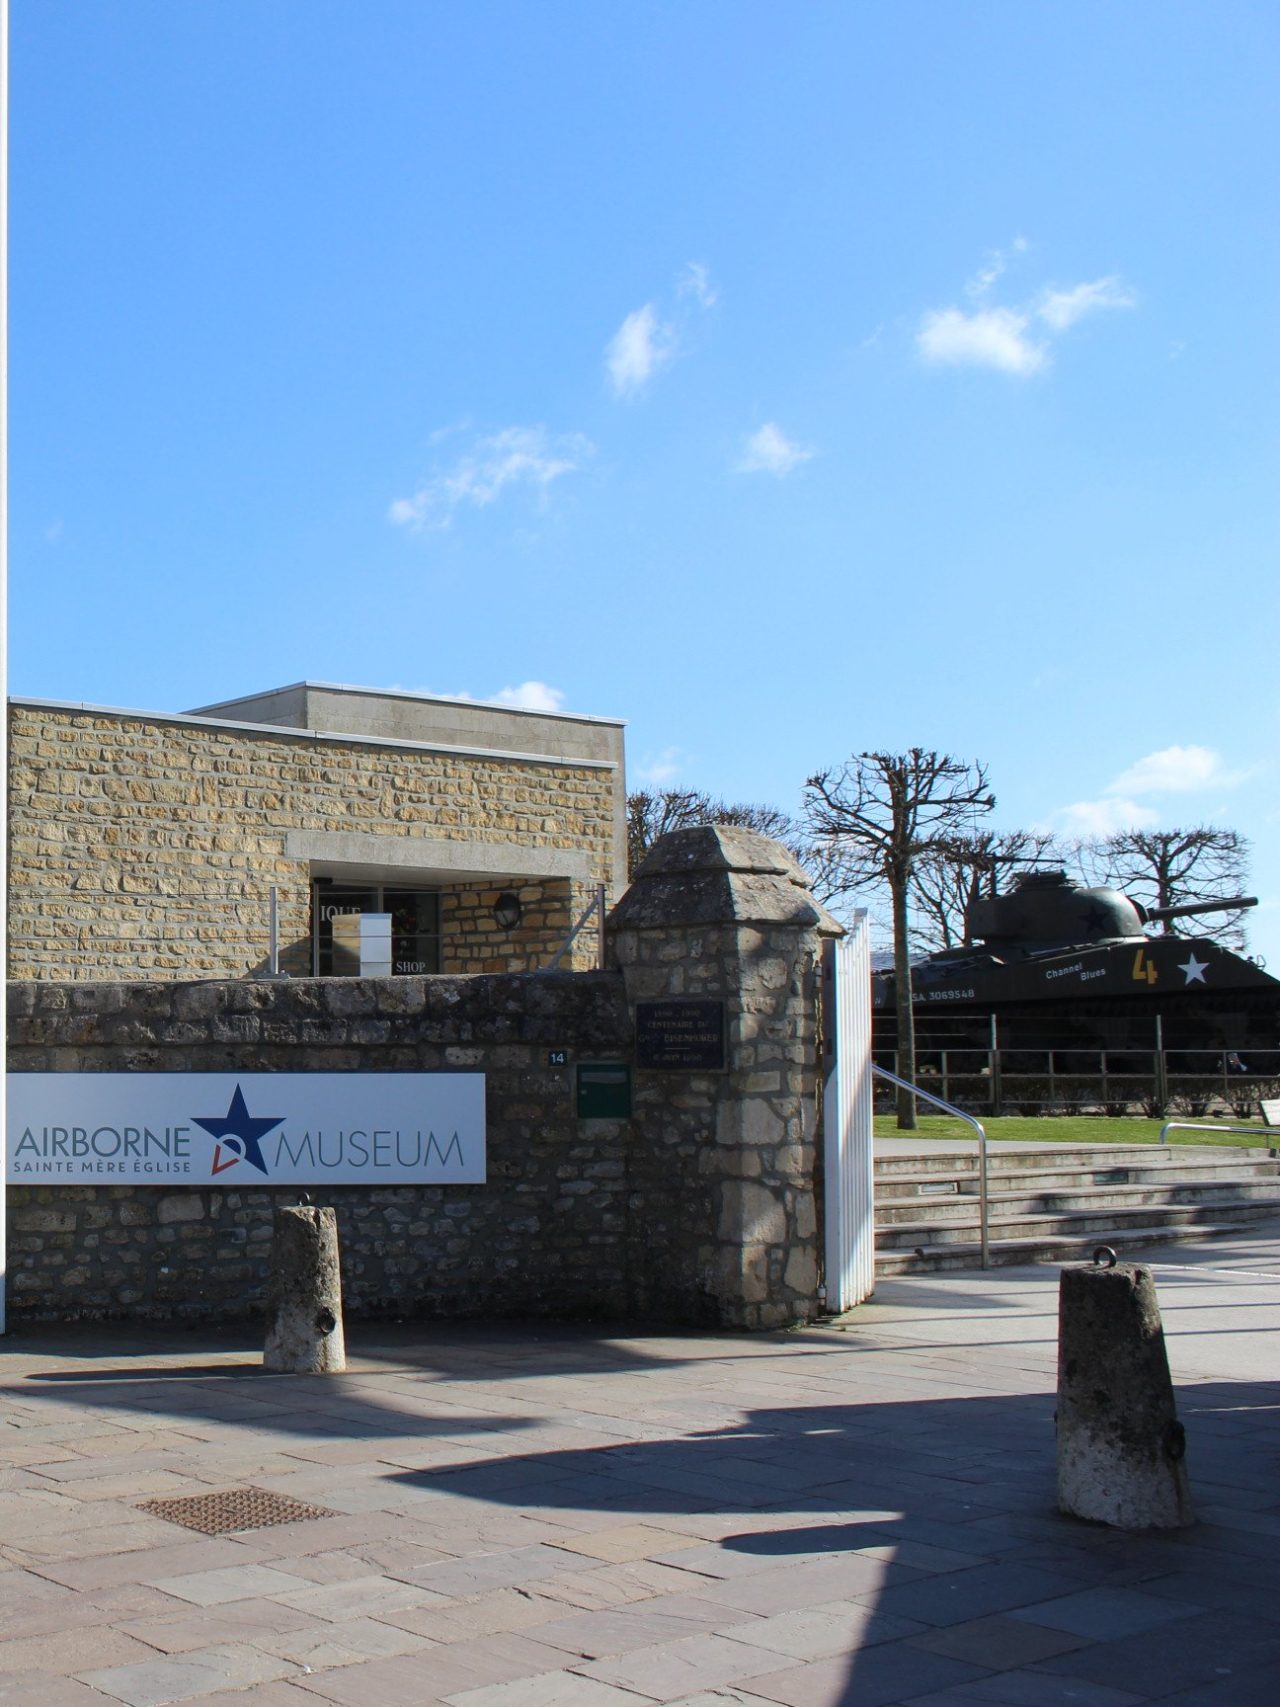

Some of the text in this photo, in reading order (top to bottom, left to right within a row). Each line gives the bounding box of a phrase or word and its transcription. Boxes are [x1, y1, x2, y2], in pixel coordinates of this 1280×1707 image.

[396, 961, 425, 973] SHOP
[1046, 962, 1083, 979] Channel
[1133, 949, 1158, 984] 4
[1080, 968, 1107, 981] Blues
[929, 989, 975, 1001] 3069548
[551, 1053, 564, 1064] 14
[14, 1127, 465, 1168] AIRBORNE MUSEUM
[14, 1159, 191, 1173] SAINTE MÈRE ÉGLISE
